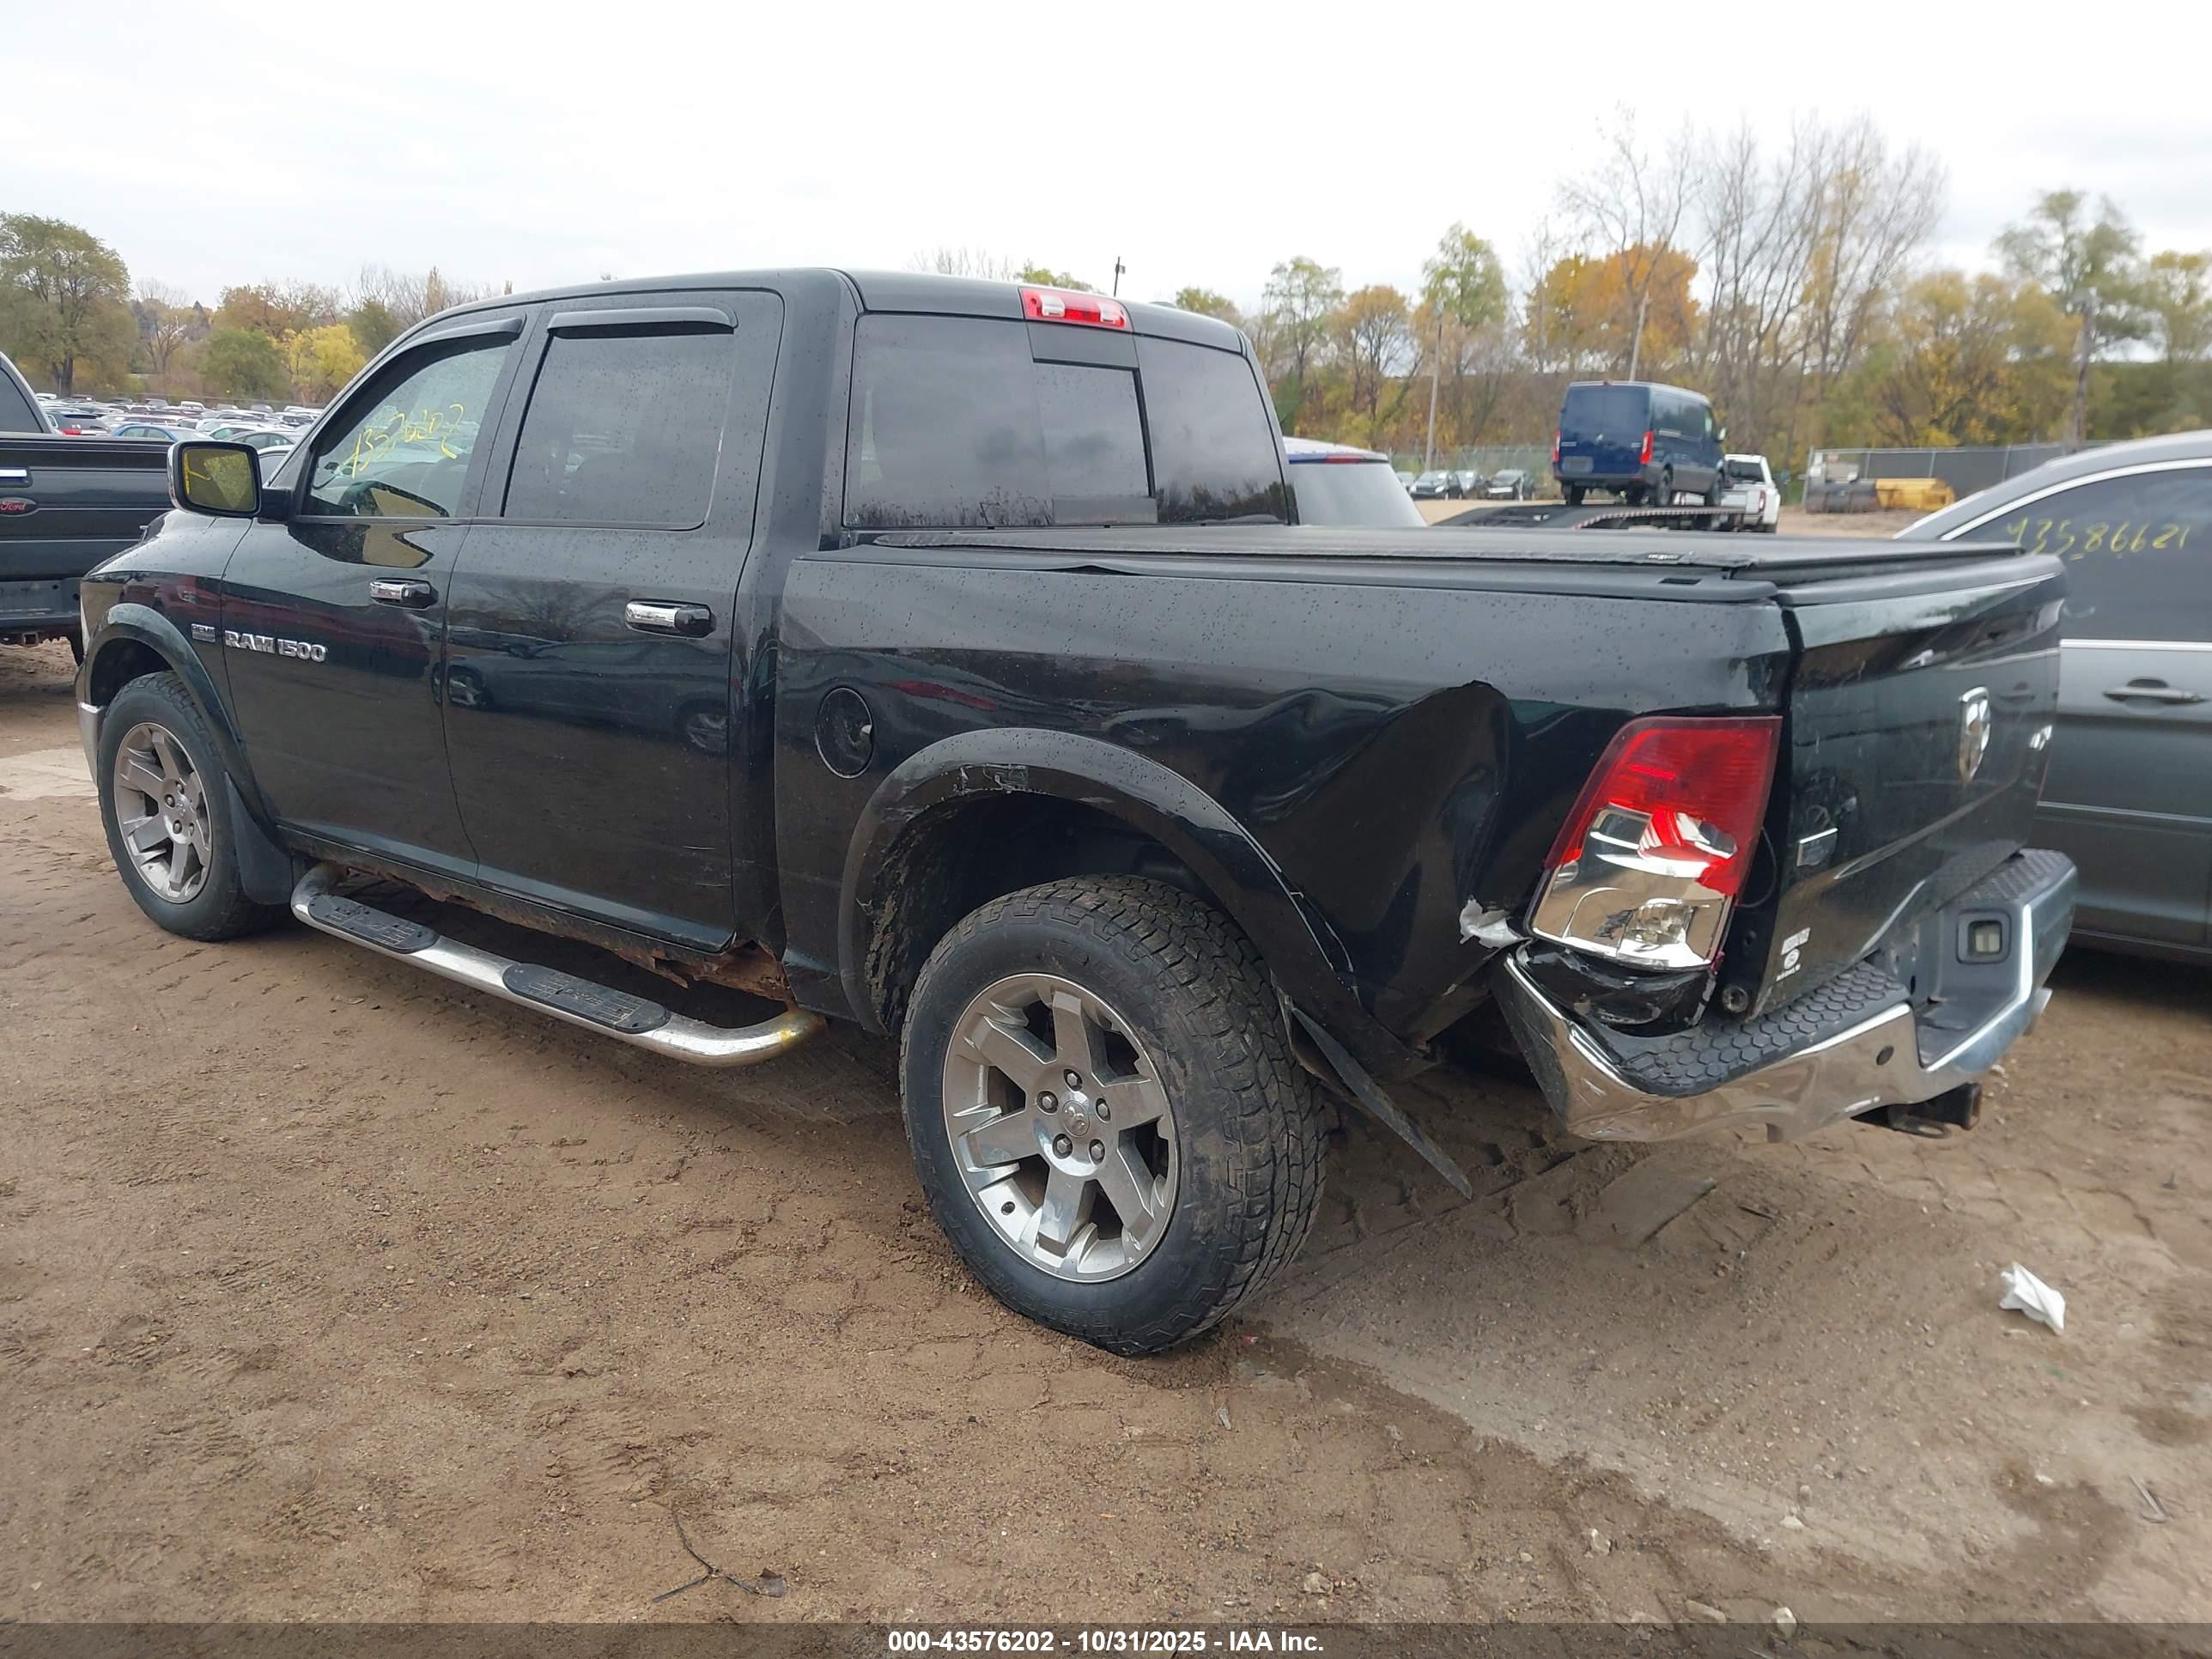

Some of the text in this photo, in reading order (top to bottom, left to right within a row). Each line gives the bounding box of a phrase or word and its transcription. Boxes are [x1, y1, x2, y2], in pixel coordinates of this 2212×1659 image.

[0, 501, 27, 512] Ford
[224, 629, 276, 654] RAM
[276, 638, 329, 663] 1500
